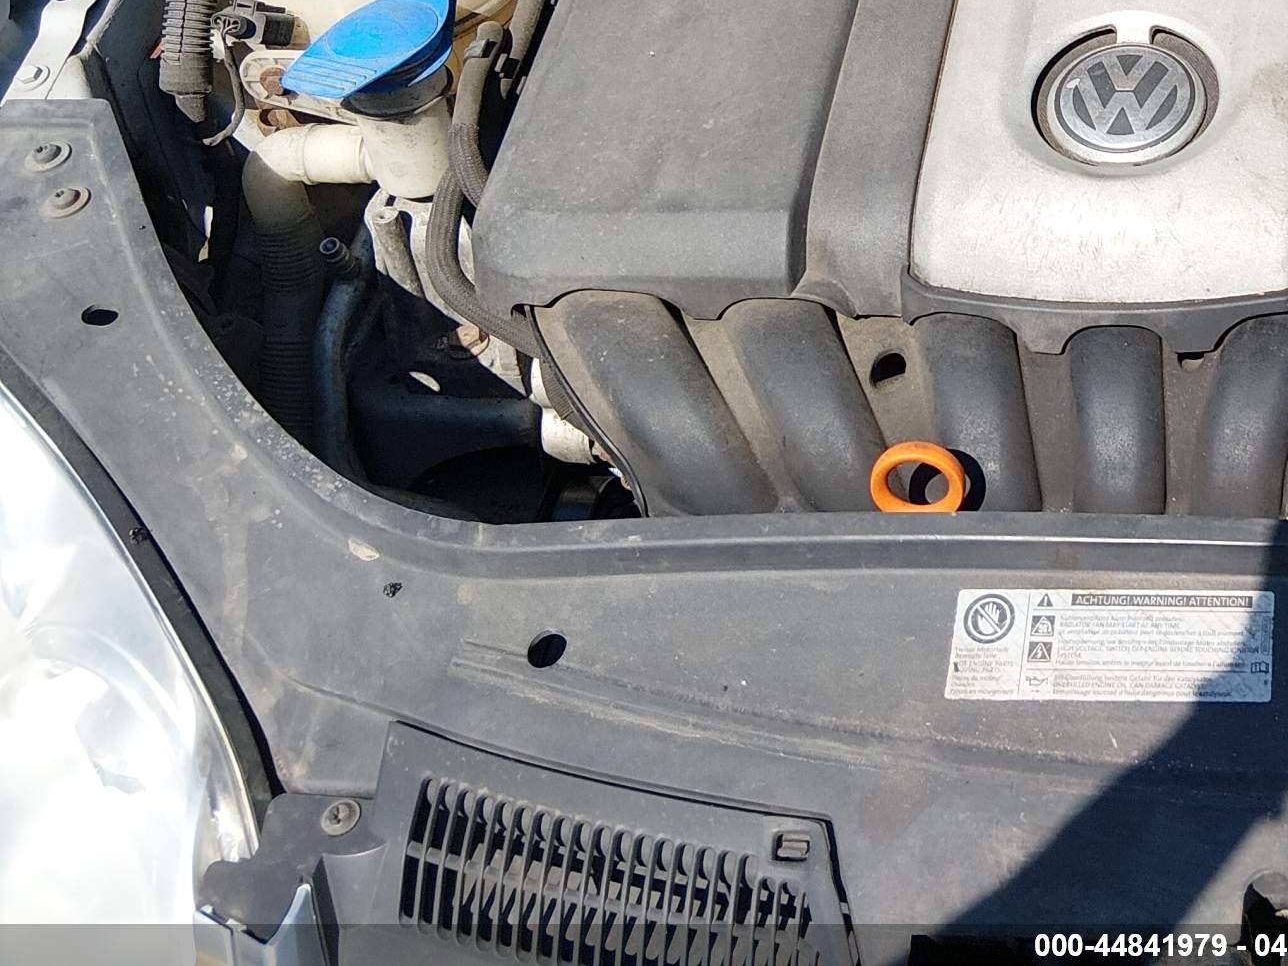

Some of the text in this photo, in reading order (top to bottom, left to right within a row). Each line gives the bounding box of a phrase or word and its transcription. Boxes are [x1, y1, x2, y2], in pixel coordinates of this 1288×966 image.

[1075, 594, 1250, 608] ACHTUNG! WARNING! ATTENTION!
